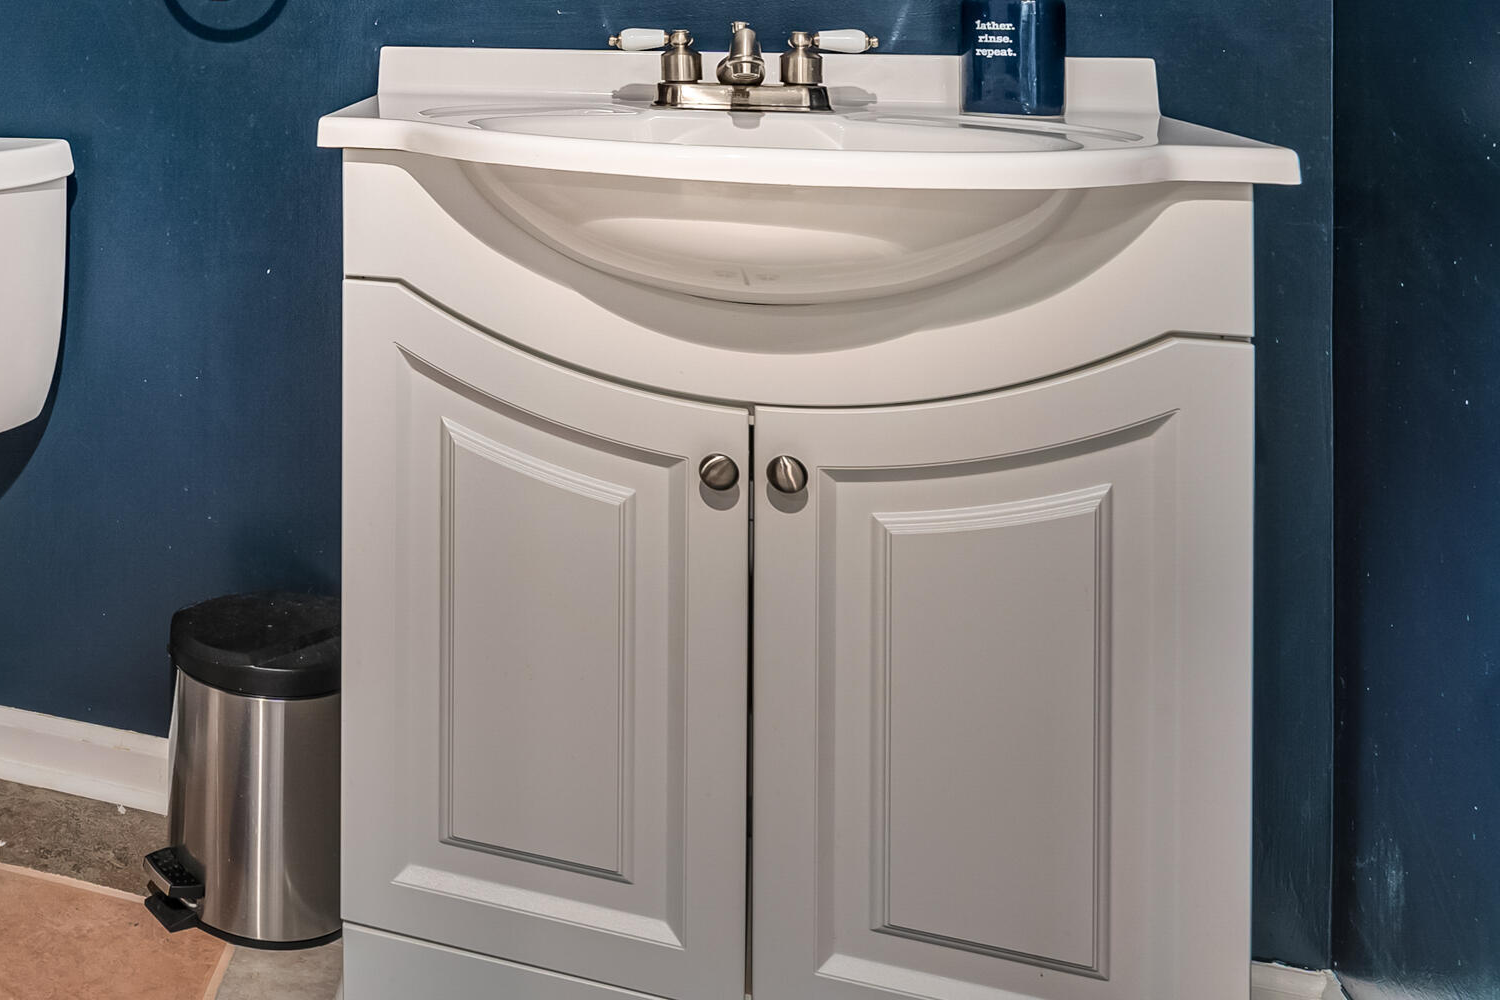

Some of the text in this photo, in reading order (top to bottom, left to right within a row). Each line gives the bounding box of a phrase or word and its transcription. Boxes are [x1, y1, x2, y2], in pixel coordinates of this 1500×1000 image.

[975, 20, 1015, 31] lather.
[978, 34, 1013, 44] rinse.
[975, 47, 1017, 58] repeat.
